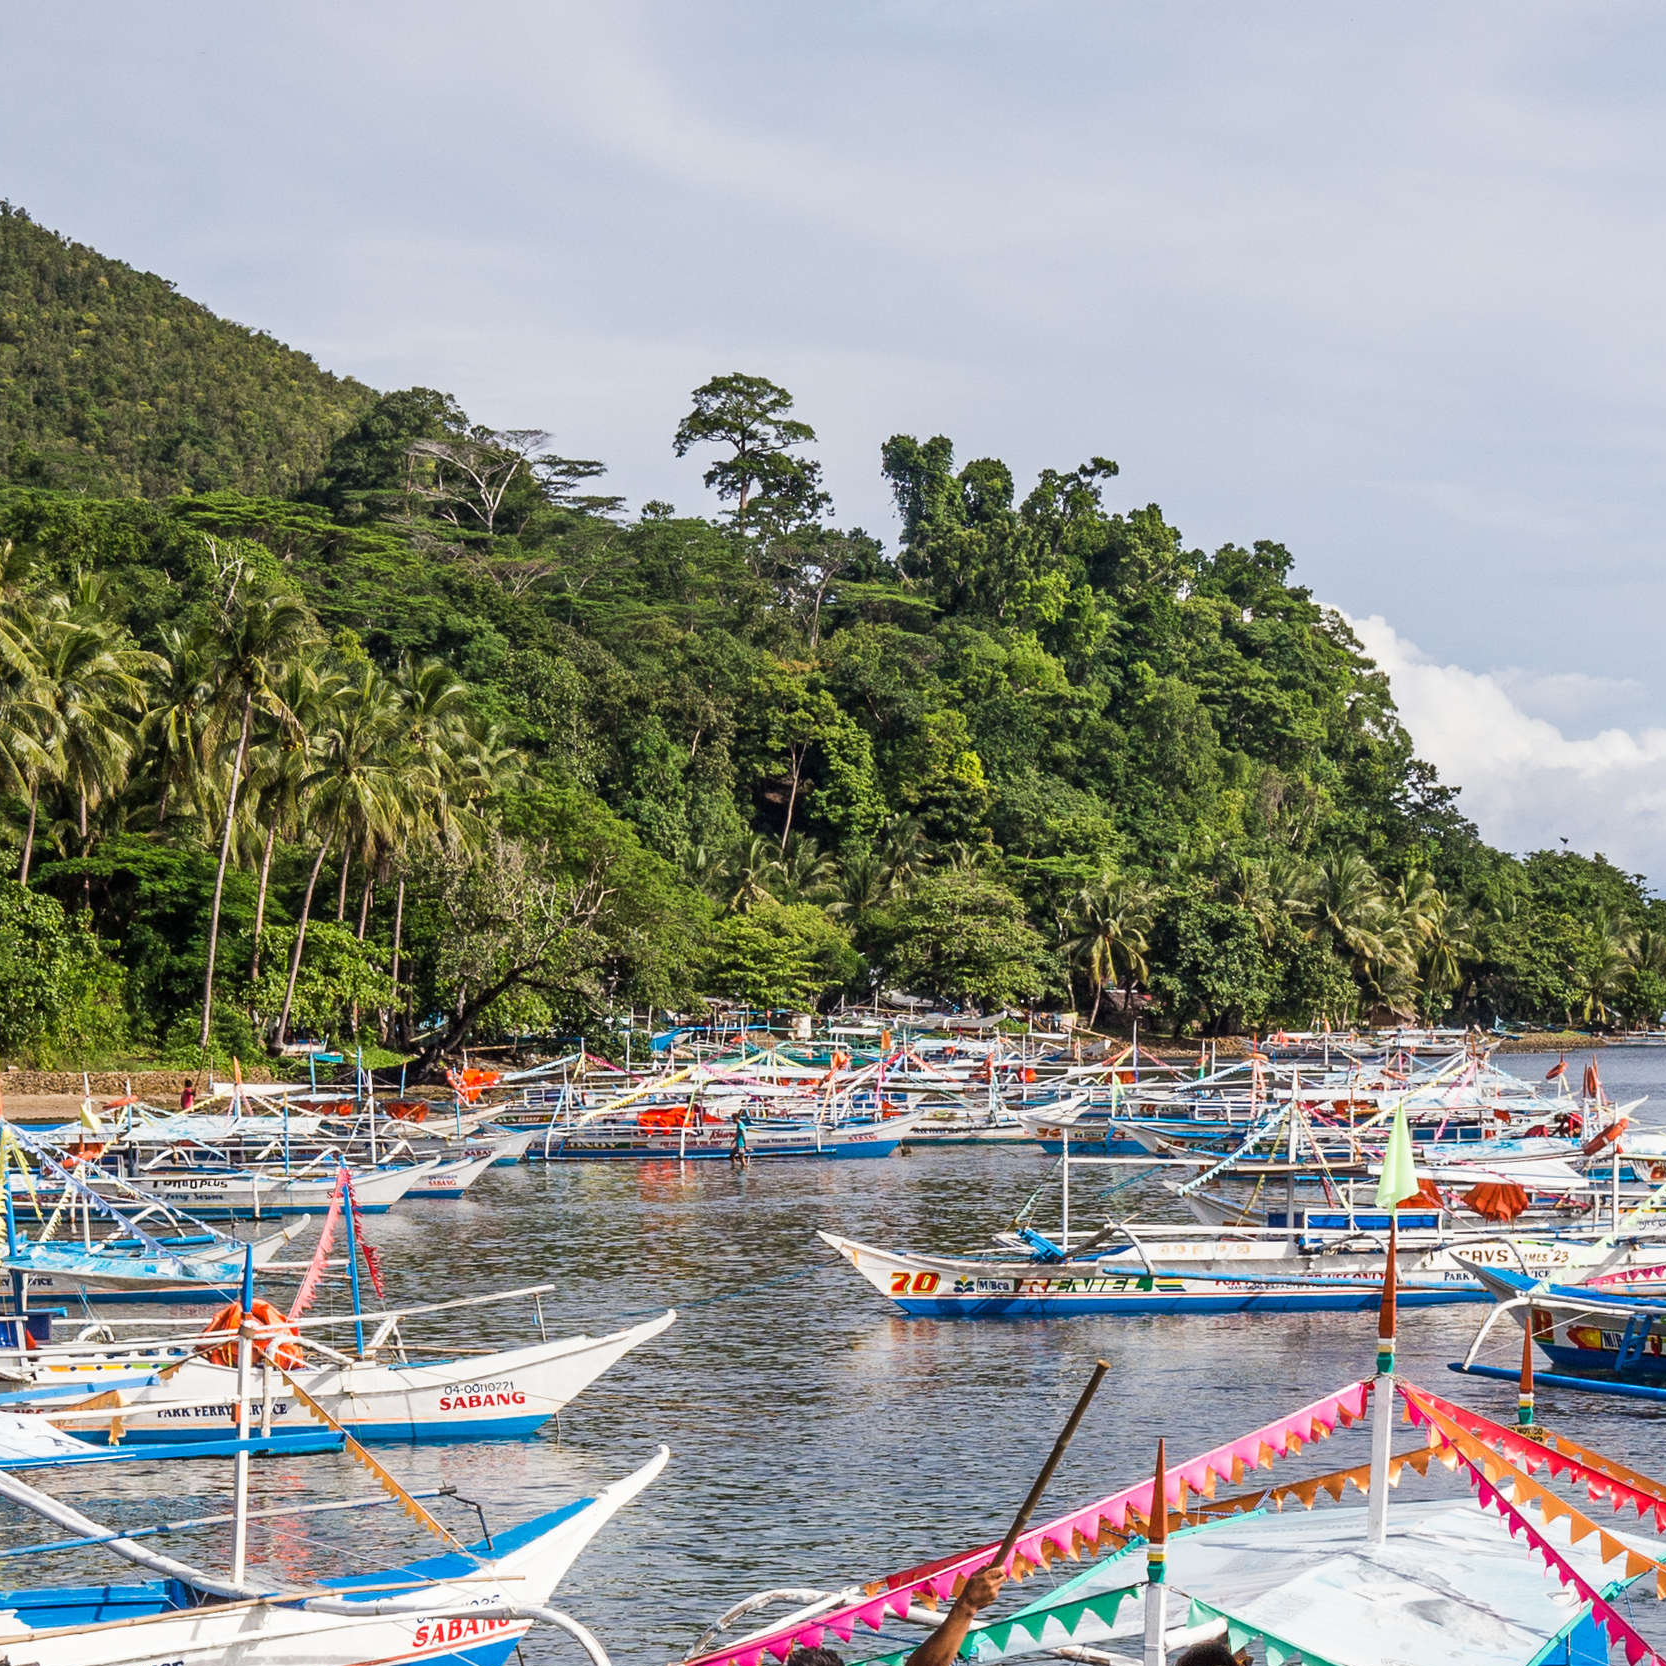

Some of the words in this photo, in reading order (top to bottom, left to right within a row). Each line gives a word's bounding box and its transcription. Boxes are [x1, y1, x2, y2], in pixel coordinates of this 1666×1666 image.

[889, 1271, 942, 1295] 70
[157, 1405, 191, 1418] PARK
[194, 1404, 233, 1418] FERRY
[439, 1391, 526, 1411] SABANG
